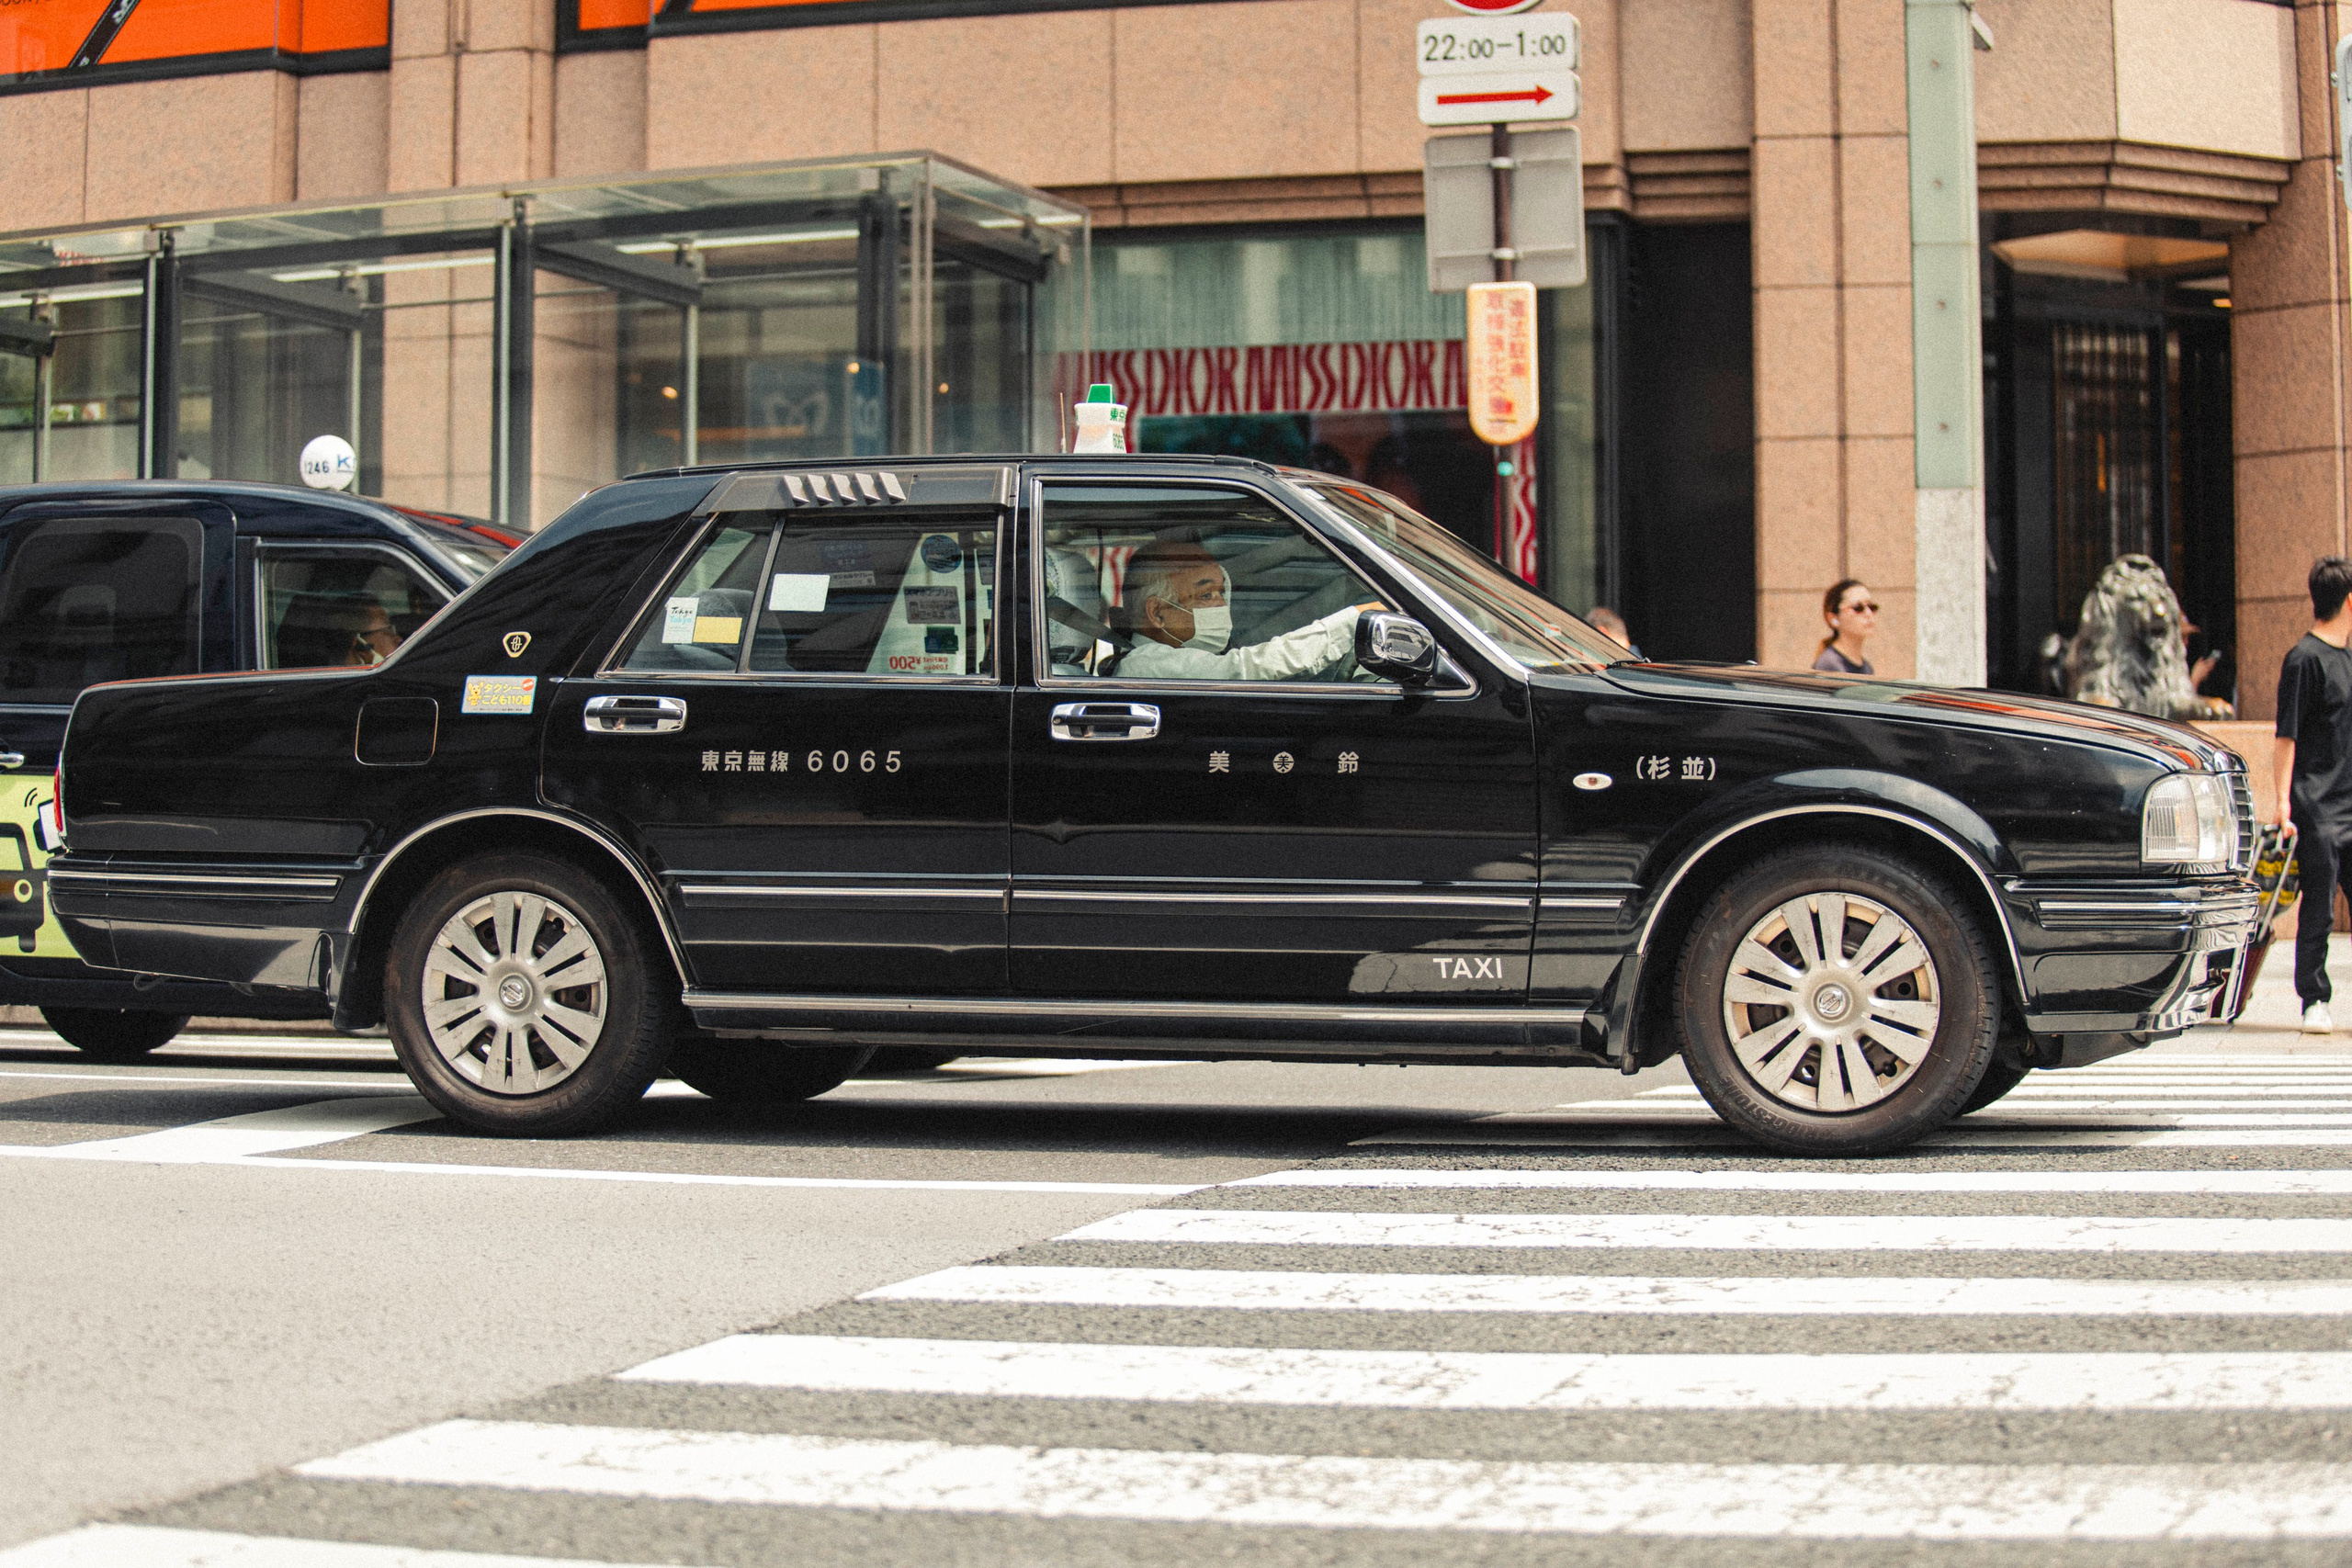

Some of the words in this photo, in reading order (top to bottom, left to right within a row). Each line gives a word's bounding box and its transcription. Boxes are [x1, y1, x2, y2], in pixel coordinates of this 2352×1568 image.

[671, 606, 693, 617] Tokyo
[670, 615, 692, 626] Tokyo
[484, 682, 522, 694] タクシー
[701, 750, 789, 772] 東京無線
[807, 750, 901, 773] 6065
[1208, 750, 1229, 773] 美
[1337, 750, 1360, 773] 鈴
[1433, 957, 1503, 979] TAXI
